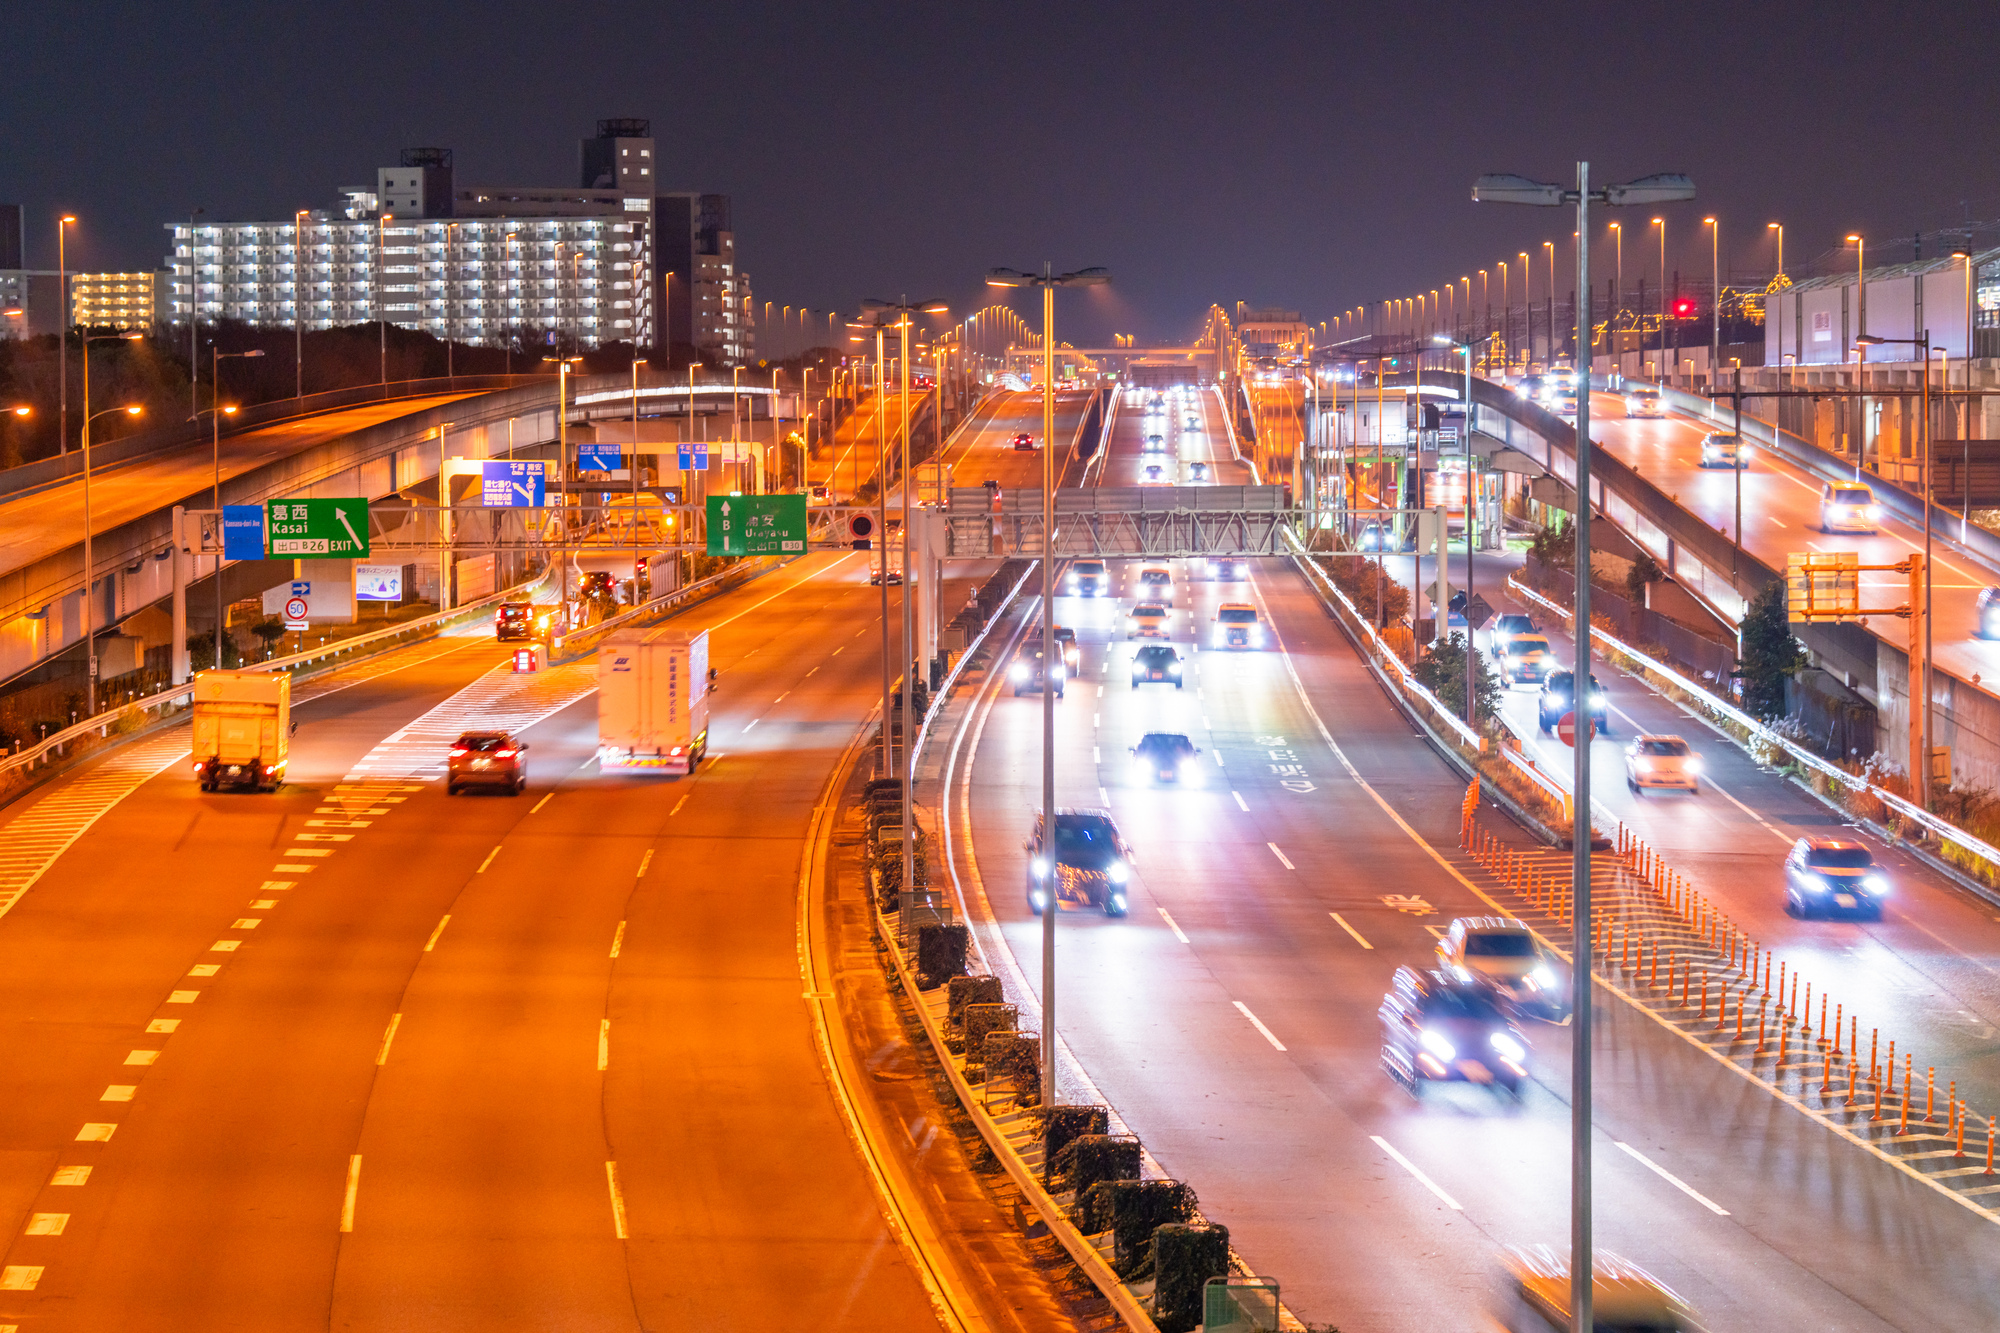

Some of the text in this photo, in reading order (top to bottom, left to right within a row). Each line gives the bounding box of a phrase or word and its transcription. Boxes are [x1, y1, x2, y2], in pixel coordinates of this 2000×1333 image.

[272, 504, 308, 520] 葛西
[272, 521, 308, 534] Kasai
[723, 519, 731, 531] B
[278, 540, 352, 552] 出口 B26 EXIT
[784, 542, 800, 550] B30
[290, 603, 303, 614] 50
